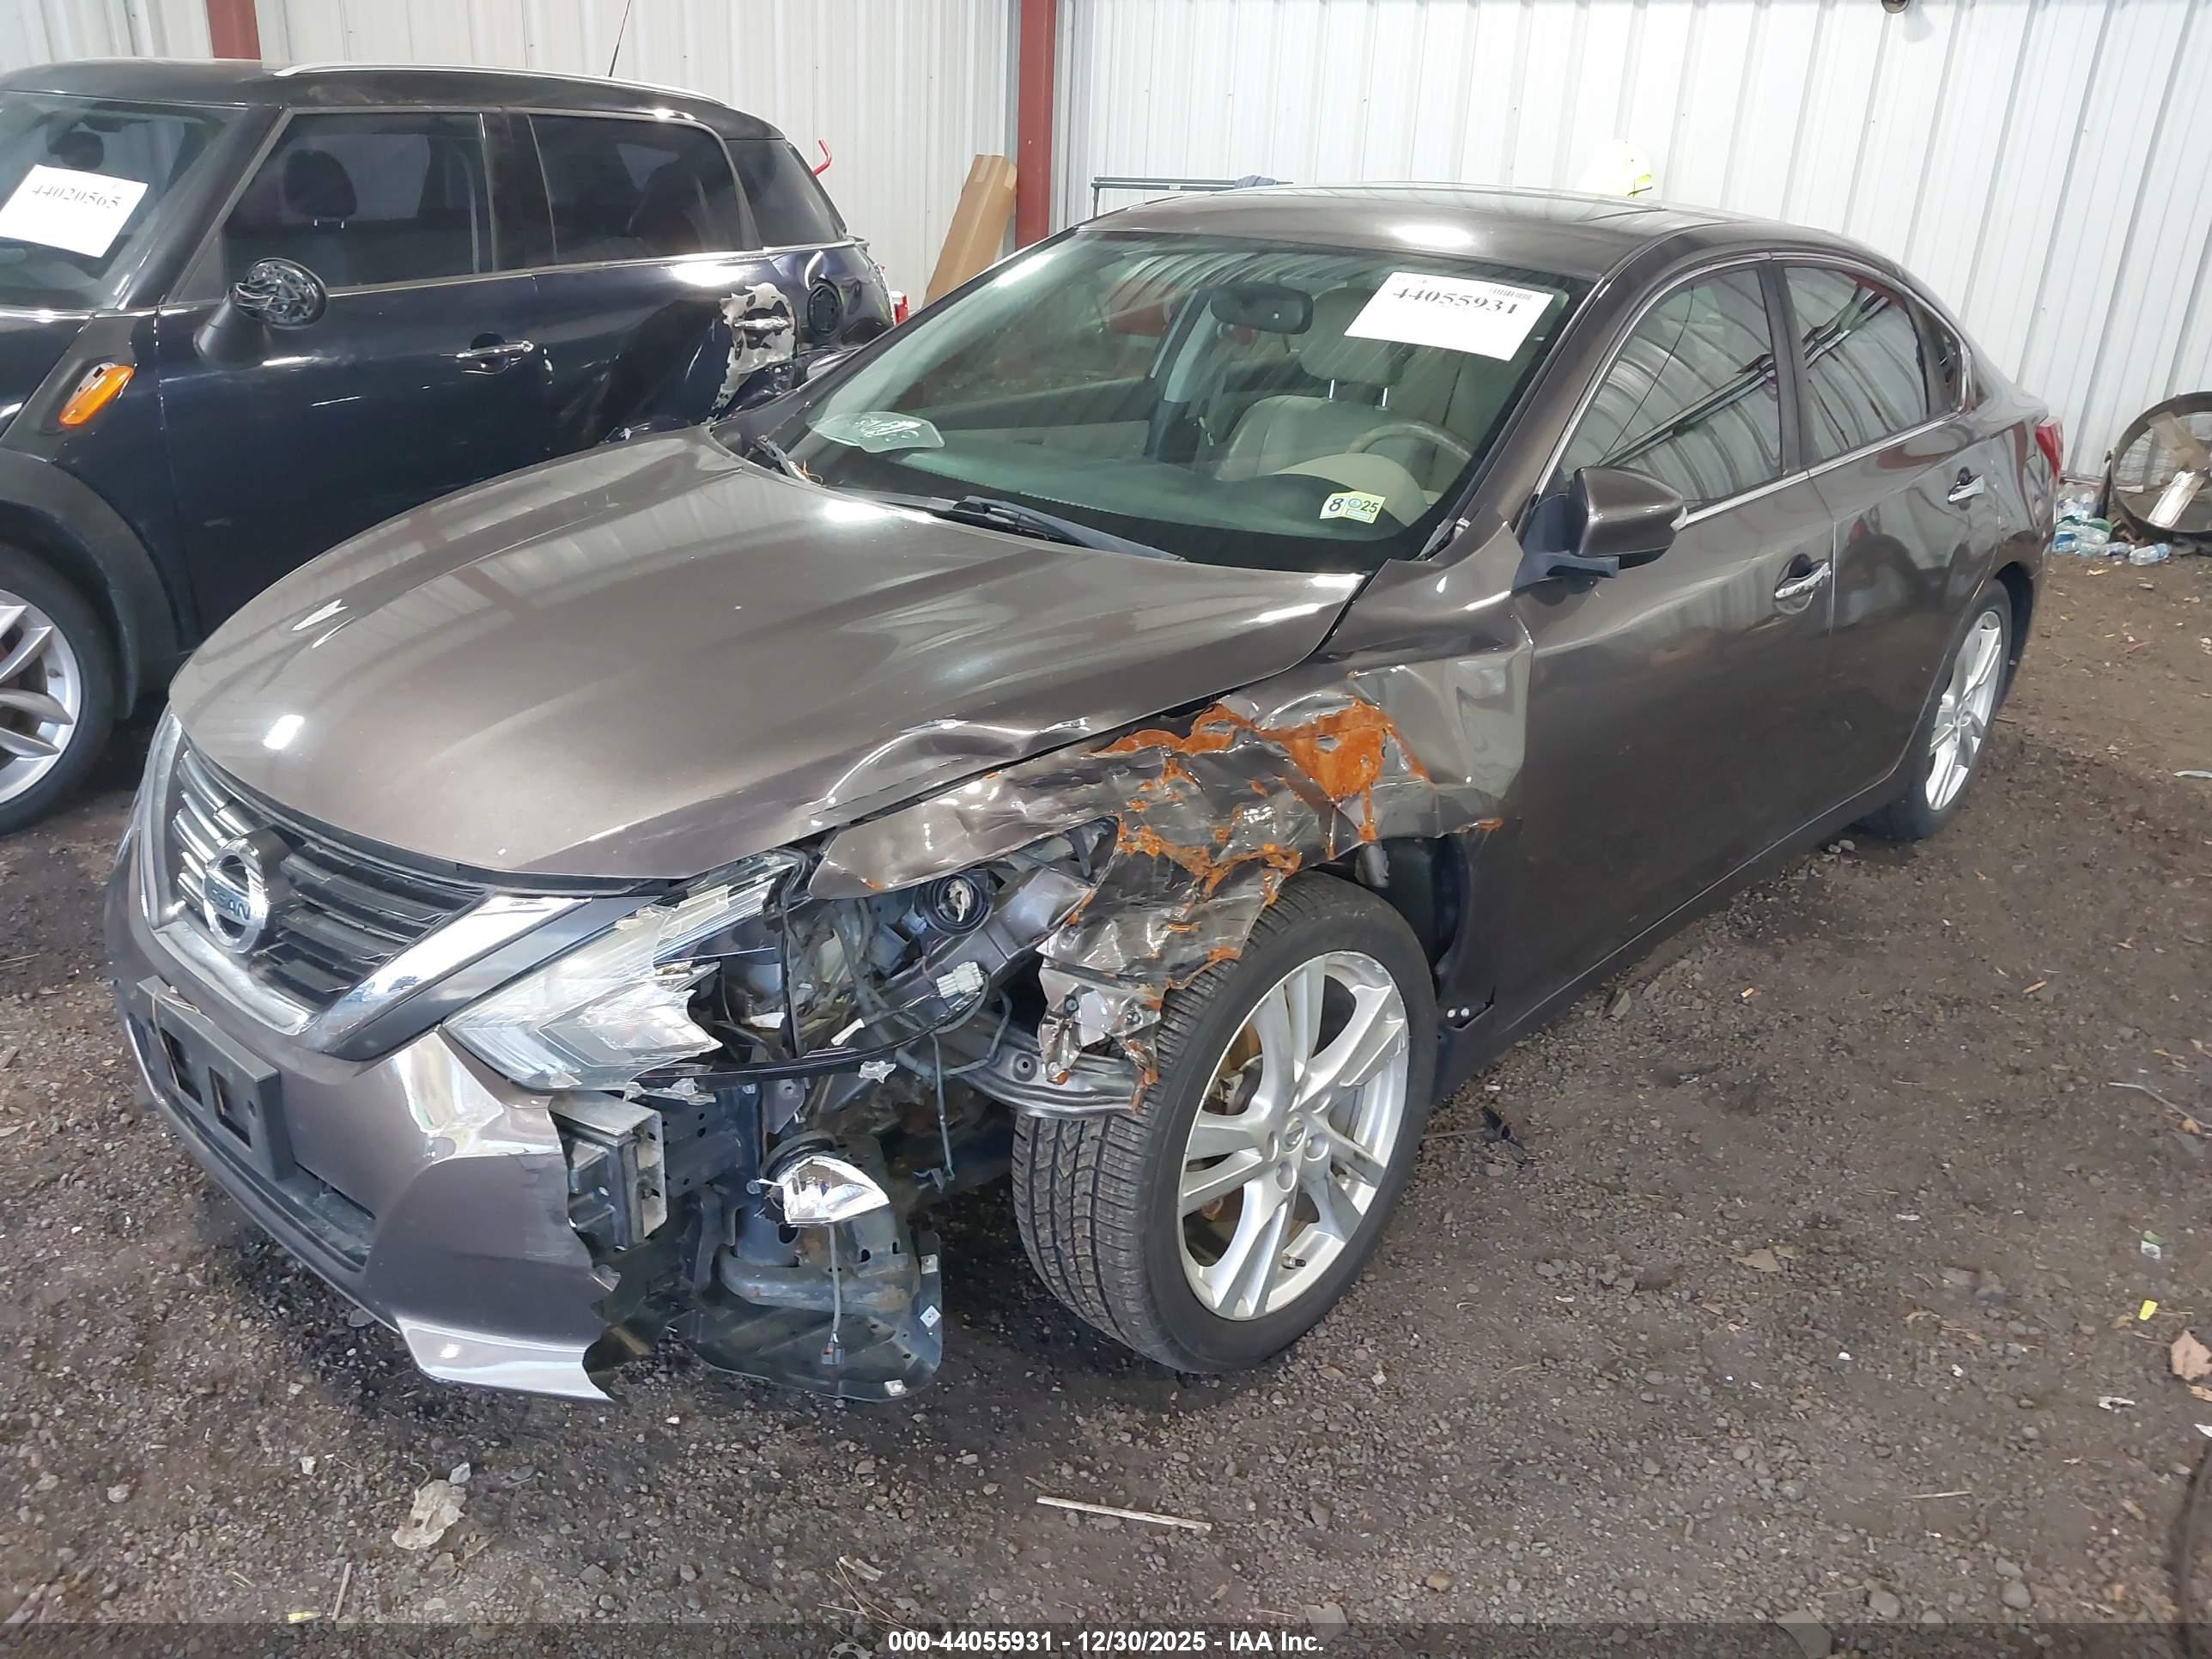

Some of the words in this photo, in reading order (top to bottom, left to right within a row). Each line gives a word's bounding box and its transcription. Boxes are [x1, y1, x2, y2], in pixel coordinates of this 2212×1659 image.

[1392, 288, 1518, 314] 44055931
[1328, 497, 1345, 513] 8
[1359, 500, 1380, 514] 25
